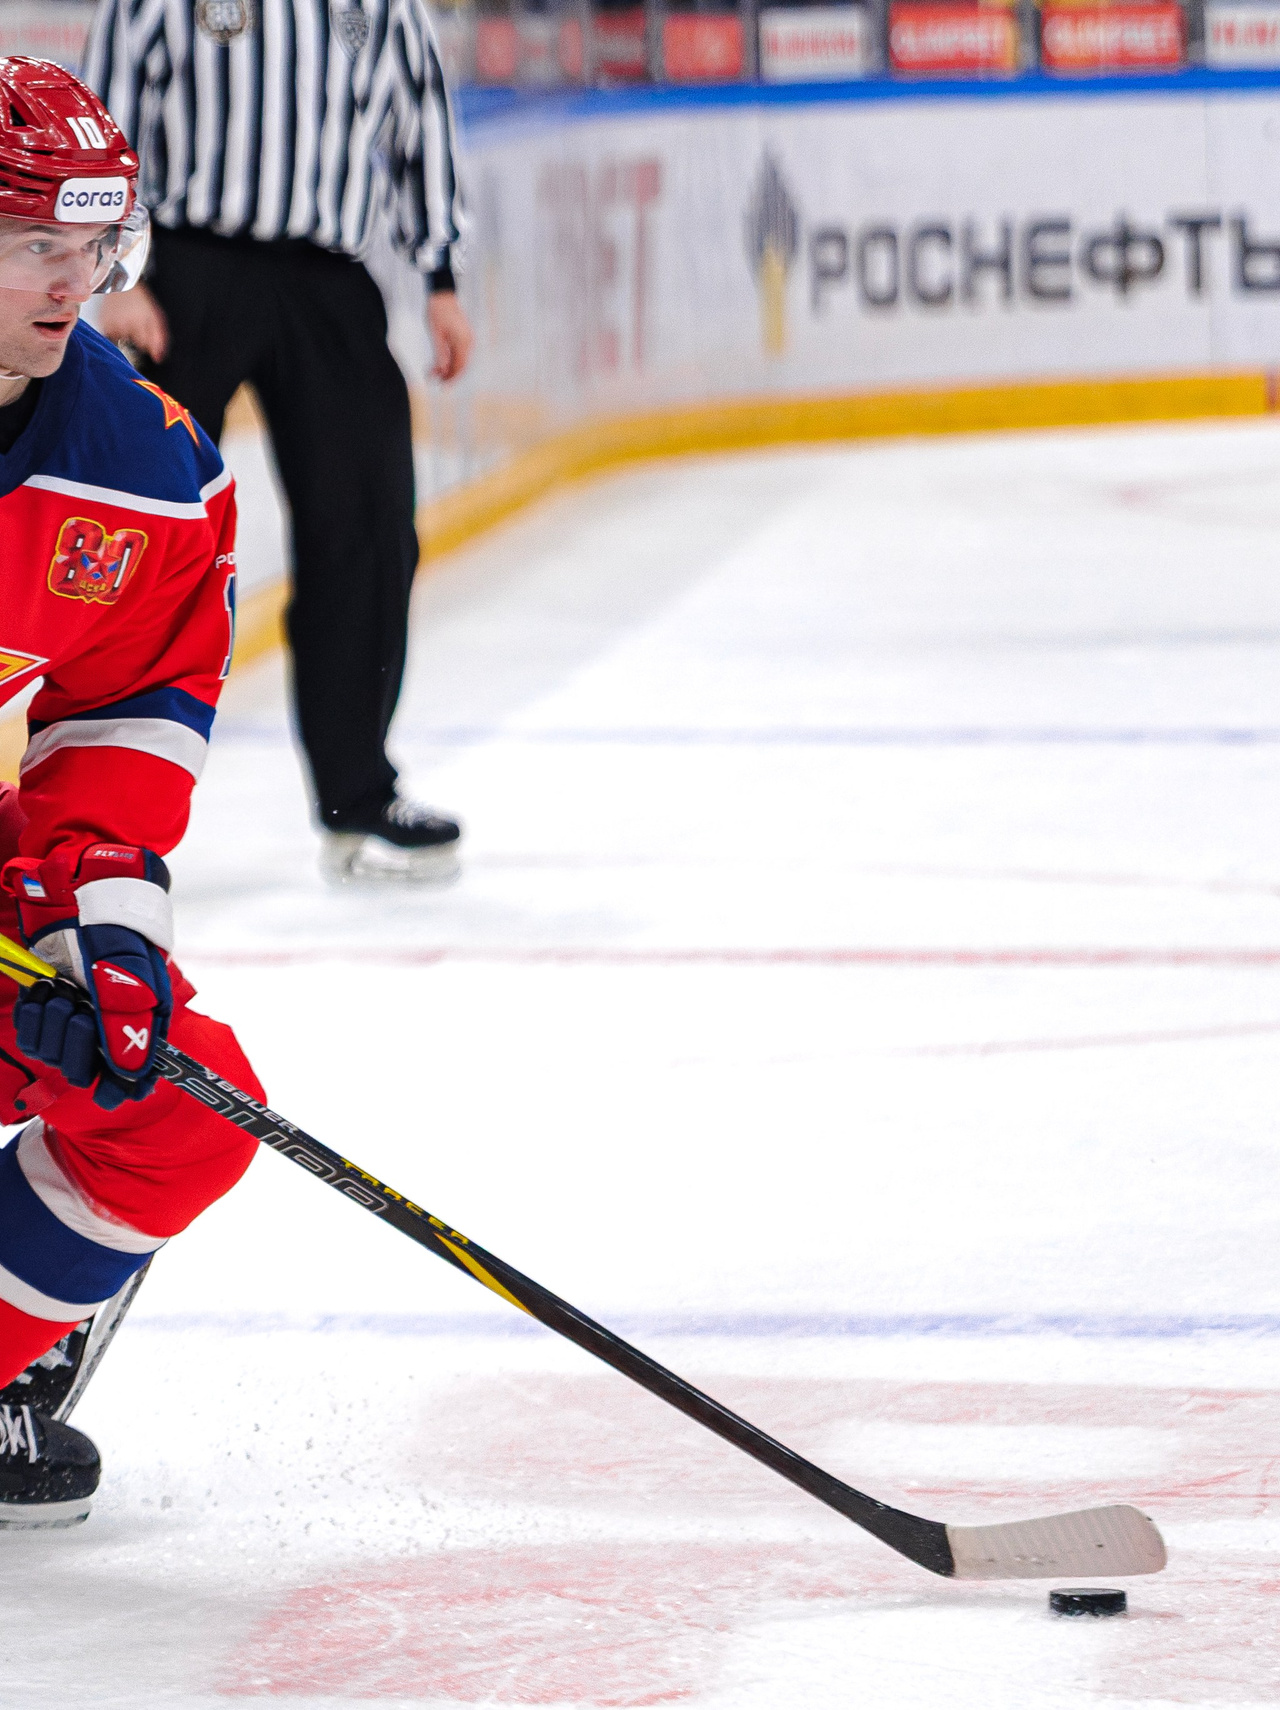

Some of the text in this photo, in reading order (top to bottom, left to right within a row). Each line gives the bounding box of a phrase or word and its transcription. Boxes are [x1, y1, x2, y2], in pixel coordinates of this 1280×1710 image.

[66, 116, 108, 150] 10
[811, 212, 1280, 310] РОСНЕФТЬ
[47, 516, 149, 605] 80
